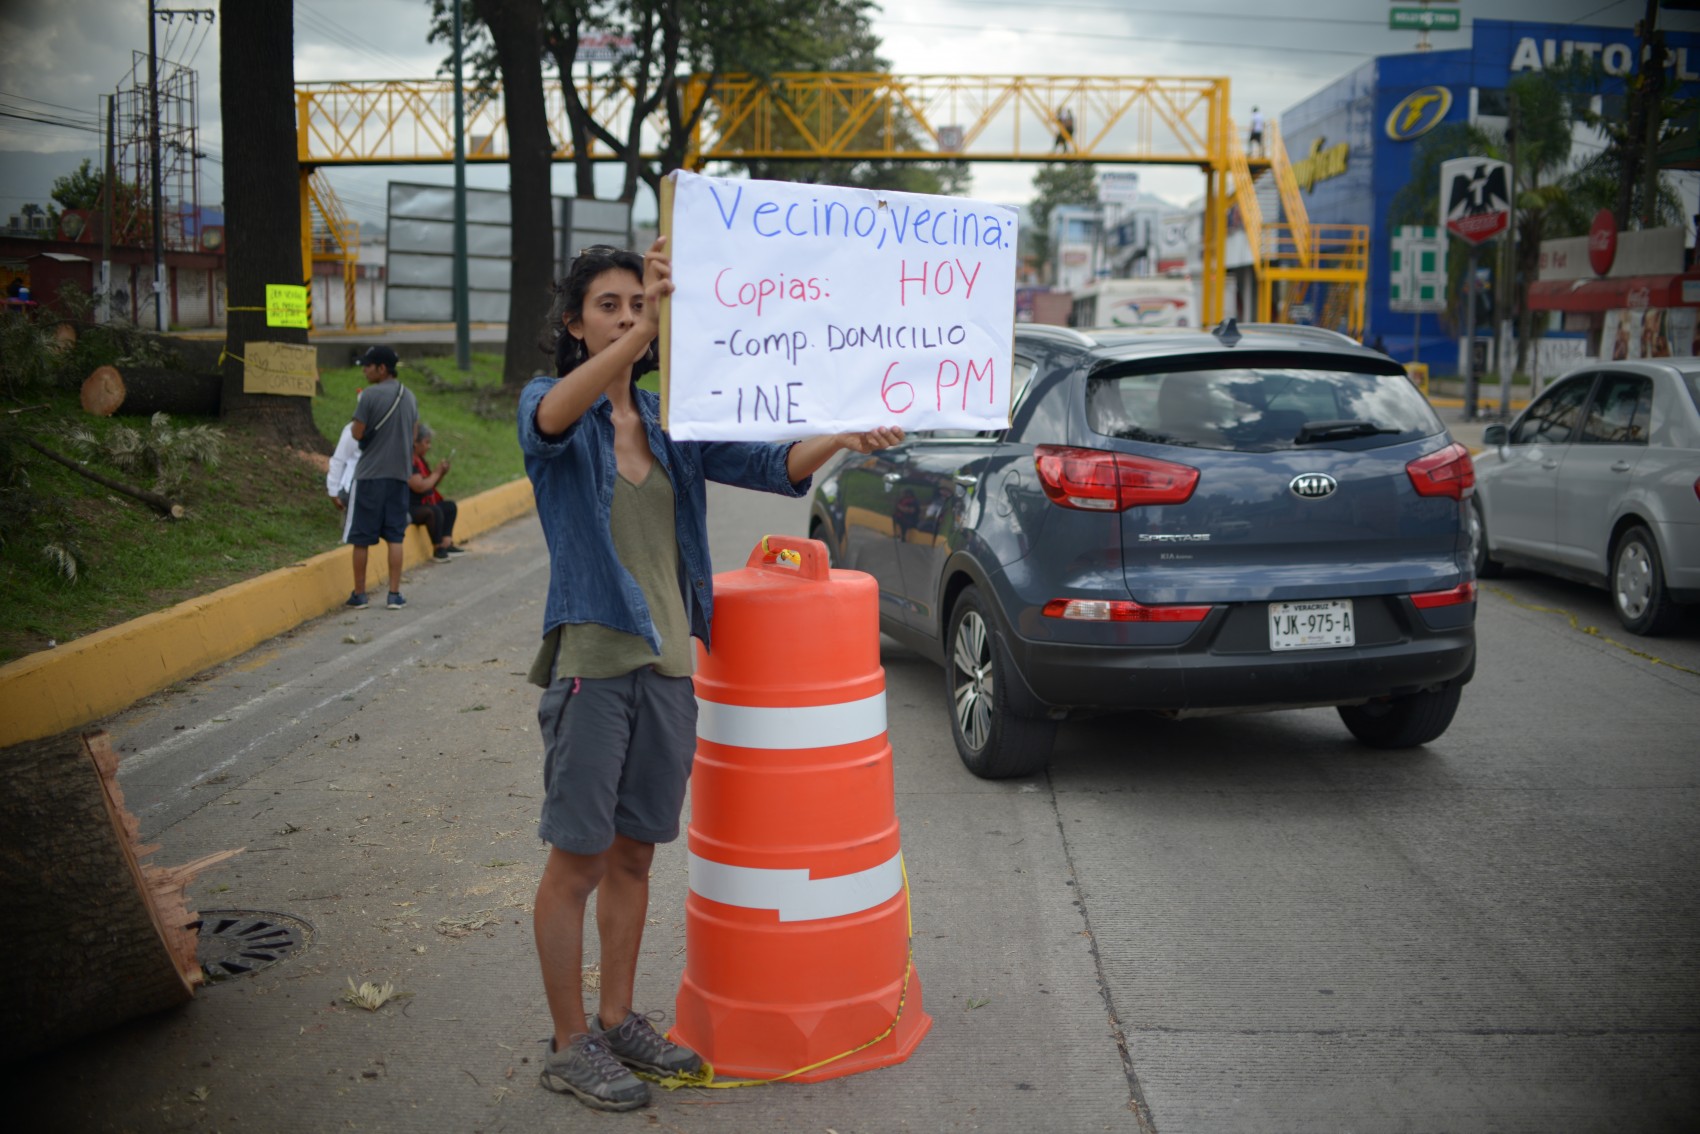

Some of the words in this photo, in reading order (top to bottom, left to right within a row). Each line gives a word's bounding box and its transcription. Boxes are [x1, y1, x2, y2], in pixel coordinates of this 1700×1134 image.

[709, 186, 888, 249] Vecino,
[714, 267, 831, 317] Copias:
[899, 257, 982, 307] HOY
[827, 323, 966, 353] DOMICILIO
[881, 361, 915, 414] 6
[936, 357, 994, 412] PM
[1297, 477, 1331, 494] KIA
[1138, 532, 1212, 543] SPORTAGE
[1293, 603, 1329, 612] VERACRUZ
[1273, 611, 1352, 636] YJK-975-A
